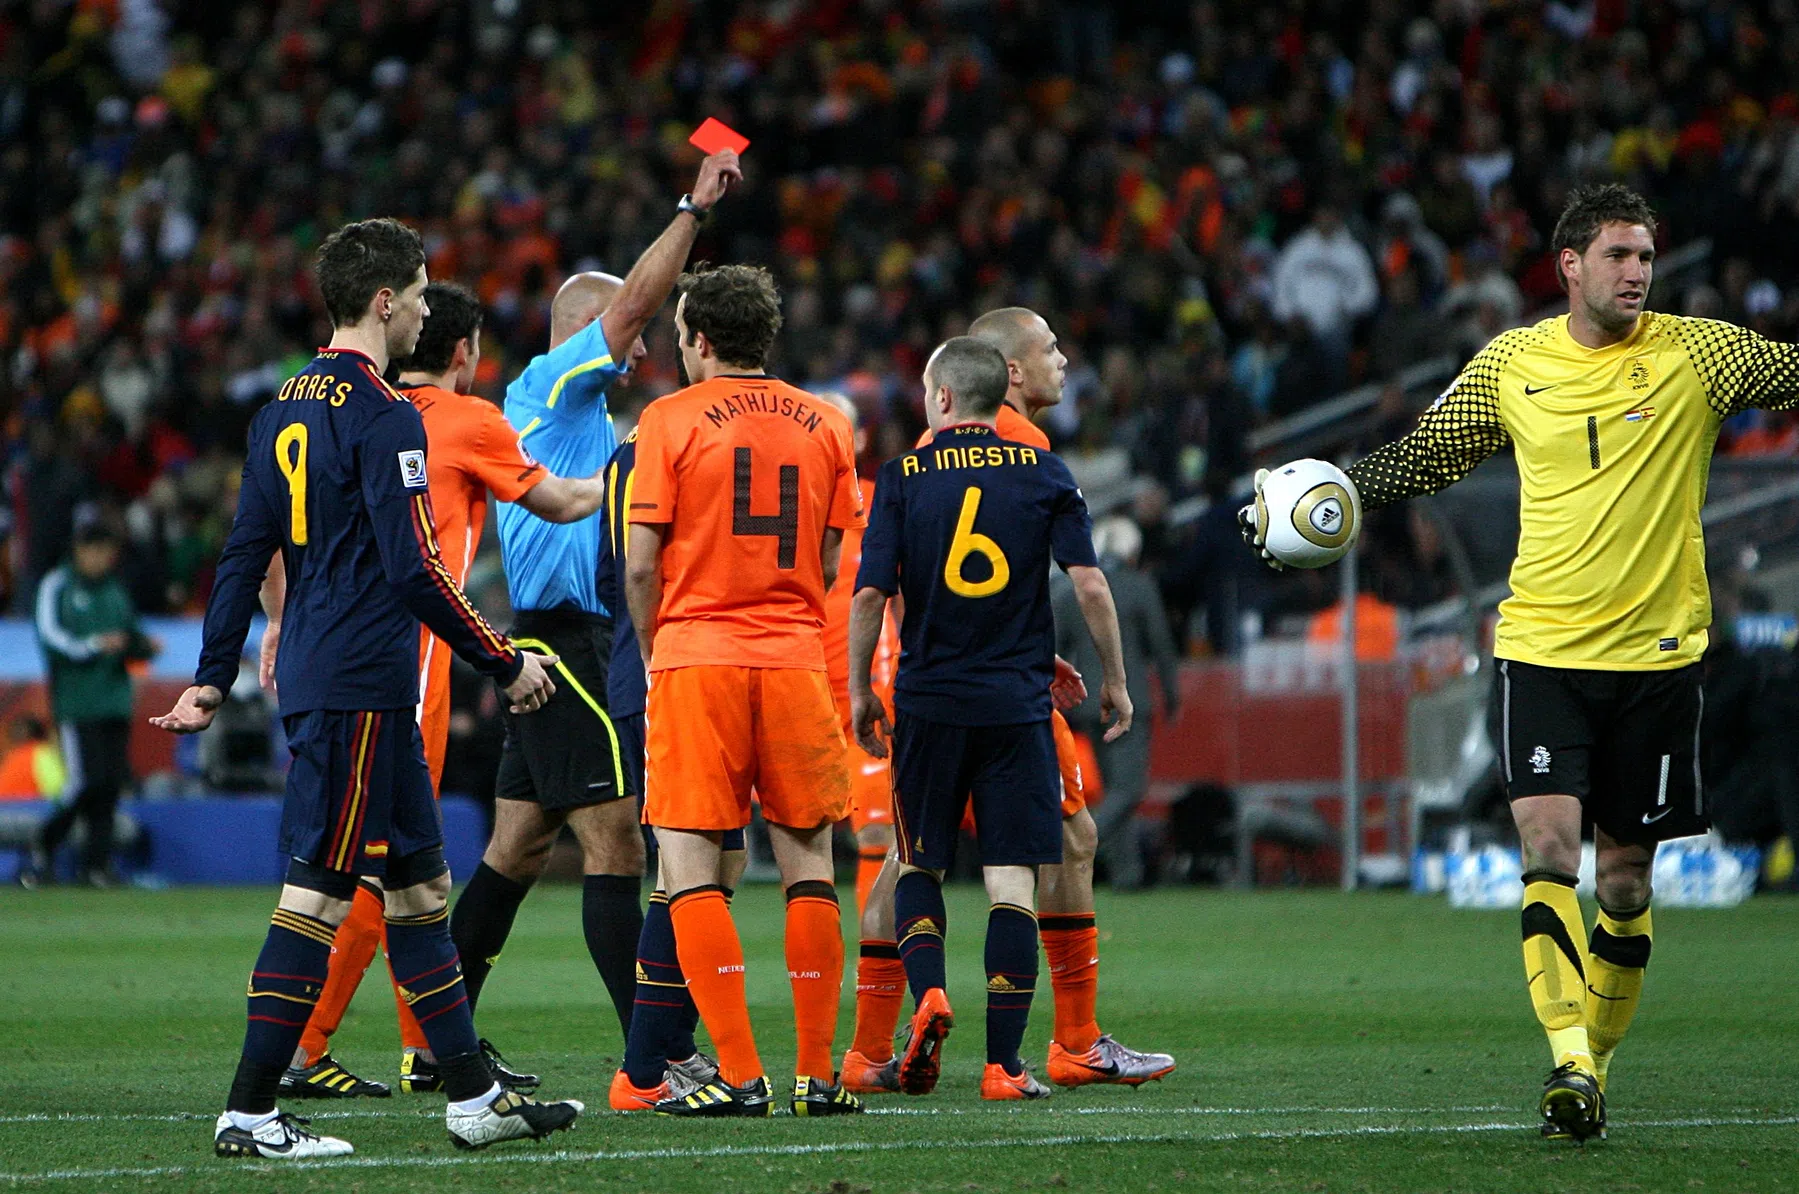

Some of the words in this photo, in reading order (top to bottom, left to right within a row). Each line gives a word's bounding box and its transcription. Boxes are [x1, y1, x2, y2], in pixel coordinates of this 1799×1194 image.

[704, 393, 822, 433] MATHIJSEN
[902, 455, 927, 476] A.
[935, 446, 1038, 470] INIESTA
[1587, 416, 1600, 469] 1
[275, 422, 308, 546] 9
[732, 447, 799, 569] 4
[944, 486, 1010, 598] 6
[1657, 754, 1670, 806] 1
